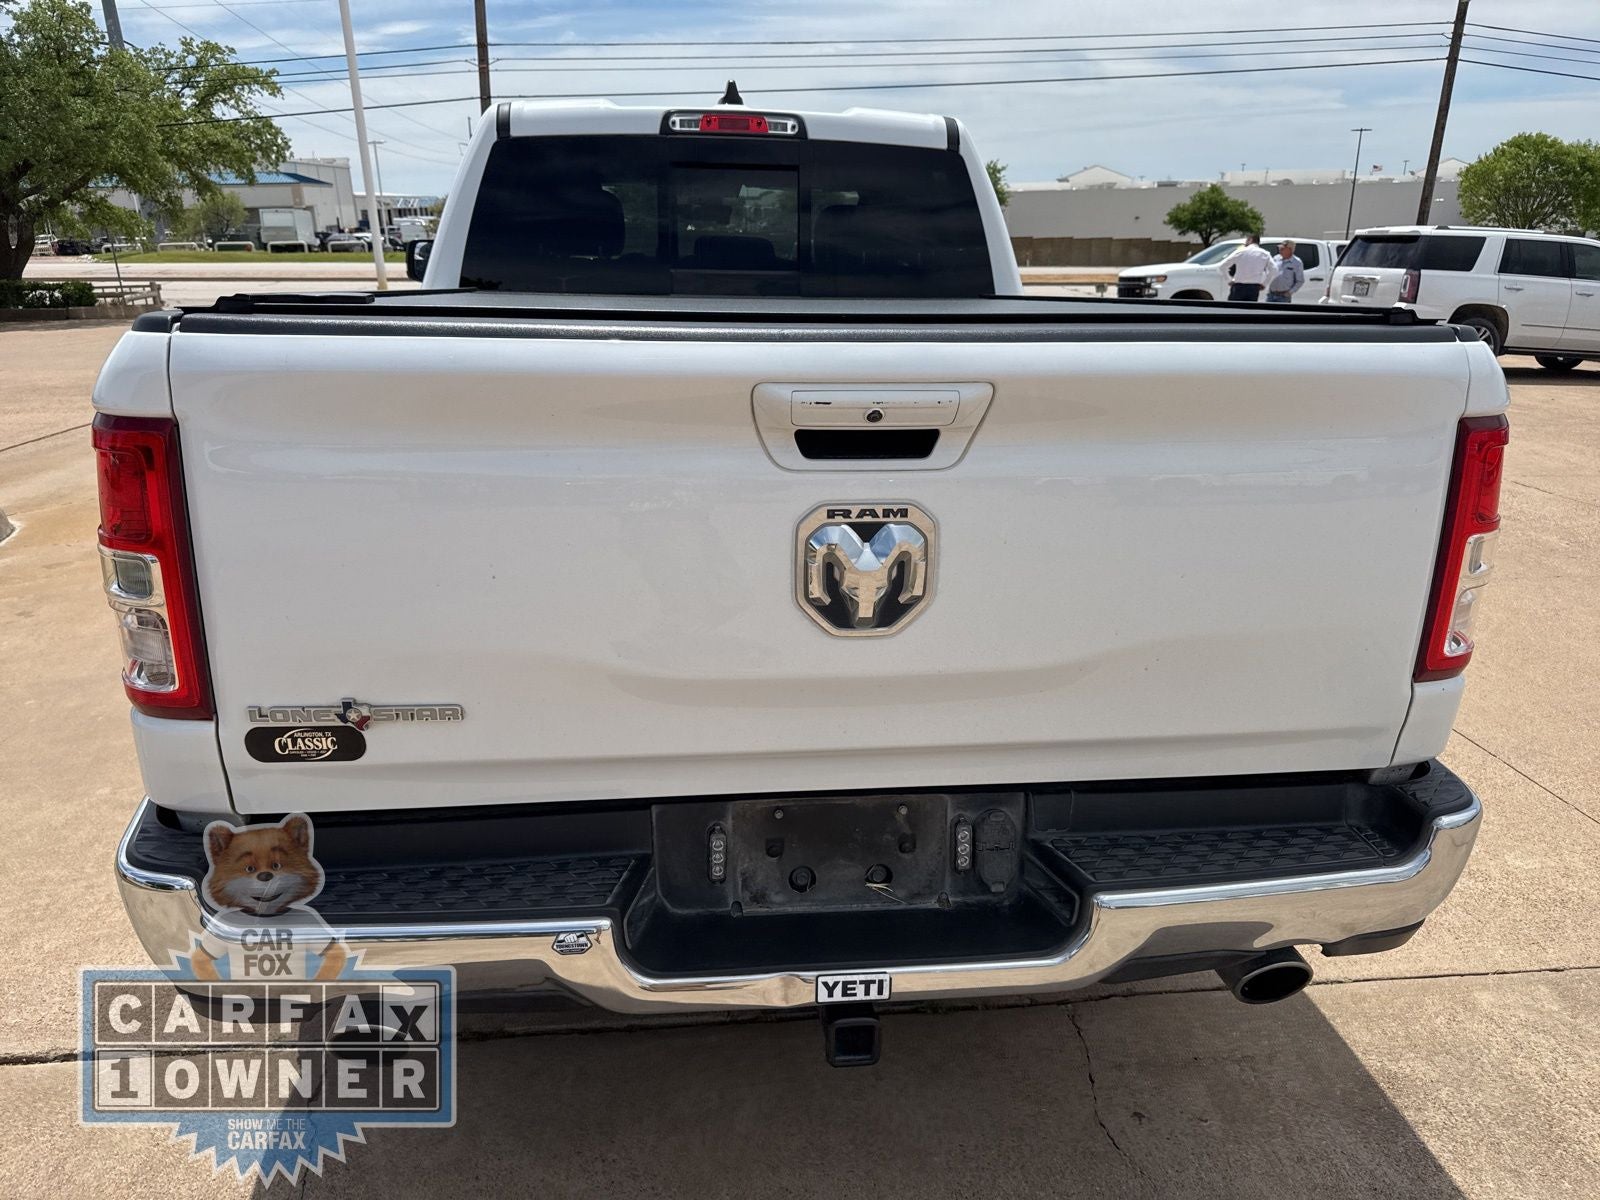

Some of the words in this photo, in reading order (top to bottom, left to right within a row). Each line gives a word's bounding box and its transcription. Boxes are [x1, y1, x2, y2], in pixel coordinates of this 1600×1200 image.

[826, 508, 909, 519] RAM
[247, 706, 338, 723] LONE
[372, 705, 464, 722] STAR
[274, 736, 338, 755] CLASSIC
[821, 979, 884, 998] YETI
